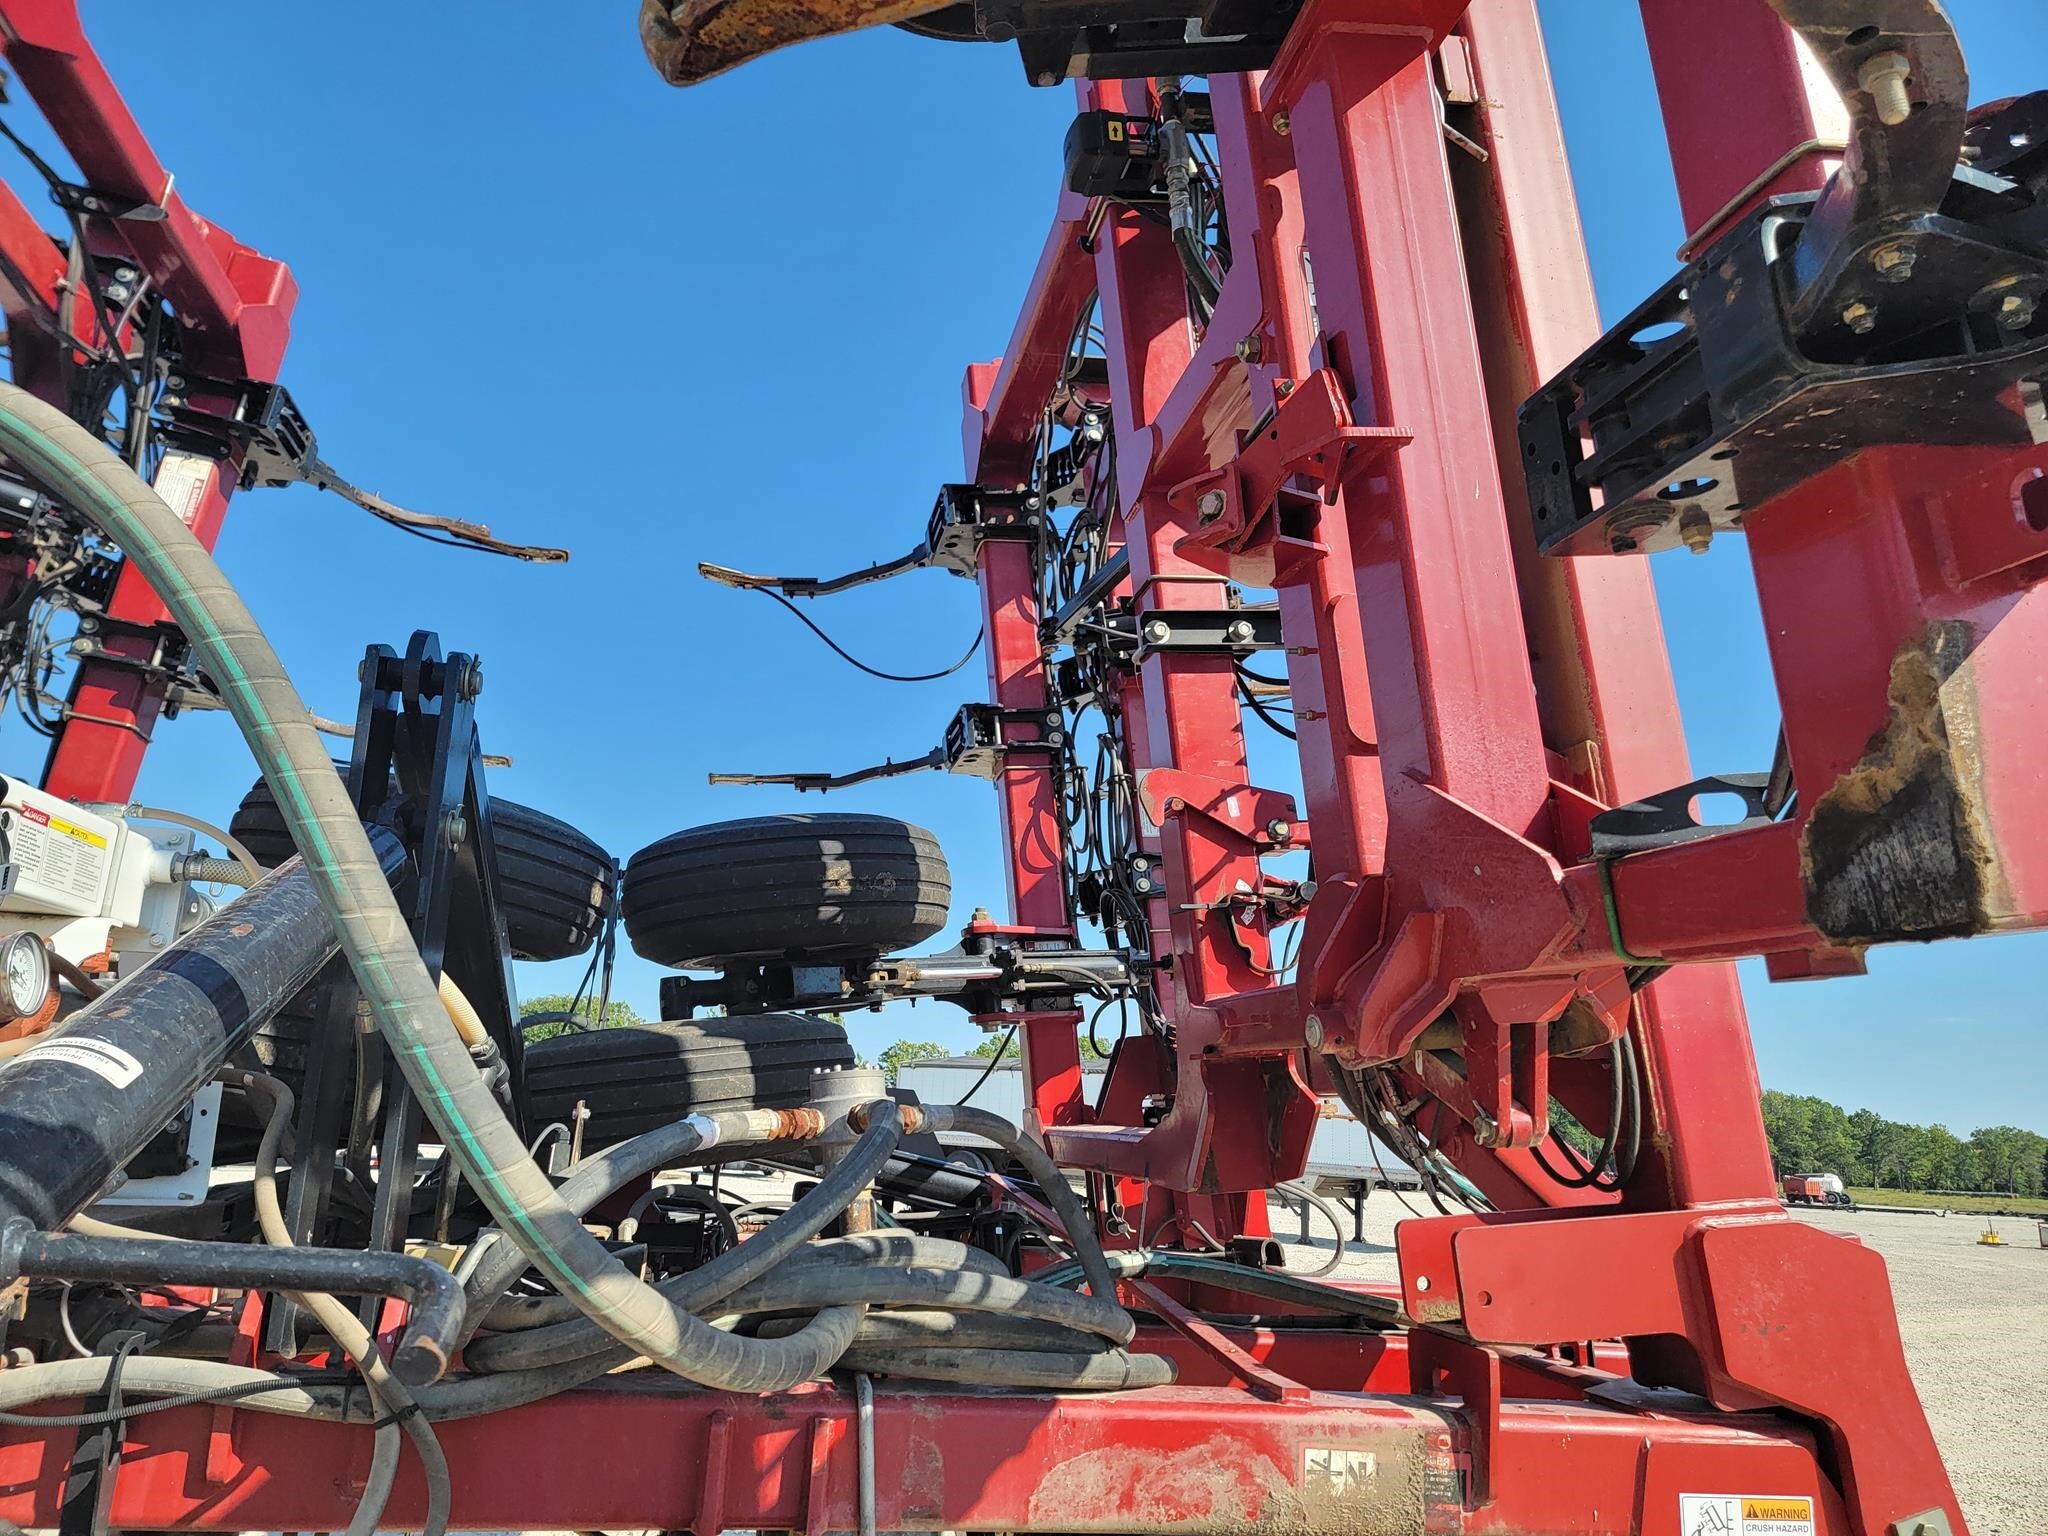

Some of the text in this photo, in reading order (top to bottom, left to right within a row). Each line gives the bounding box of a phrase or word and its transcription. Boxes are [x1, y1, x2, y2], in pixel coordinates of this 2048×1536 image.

[1759, 1507, 1808, 1520] WARNING
[1745, 1523, 1809, 1533] CRUSH HAZARD
